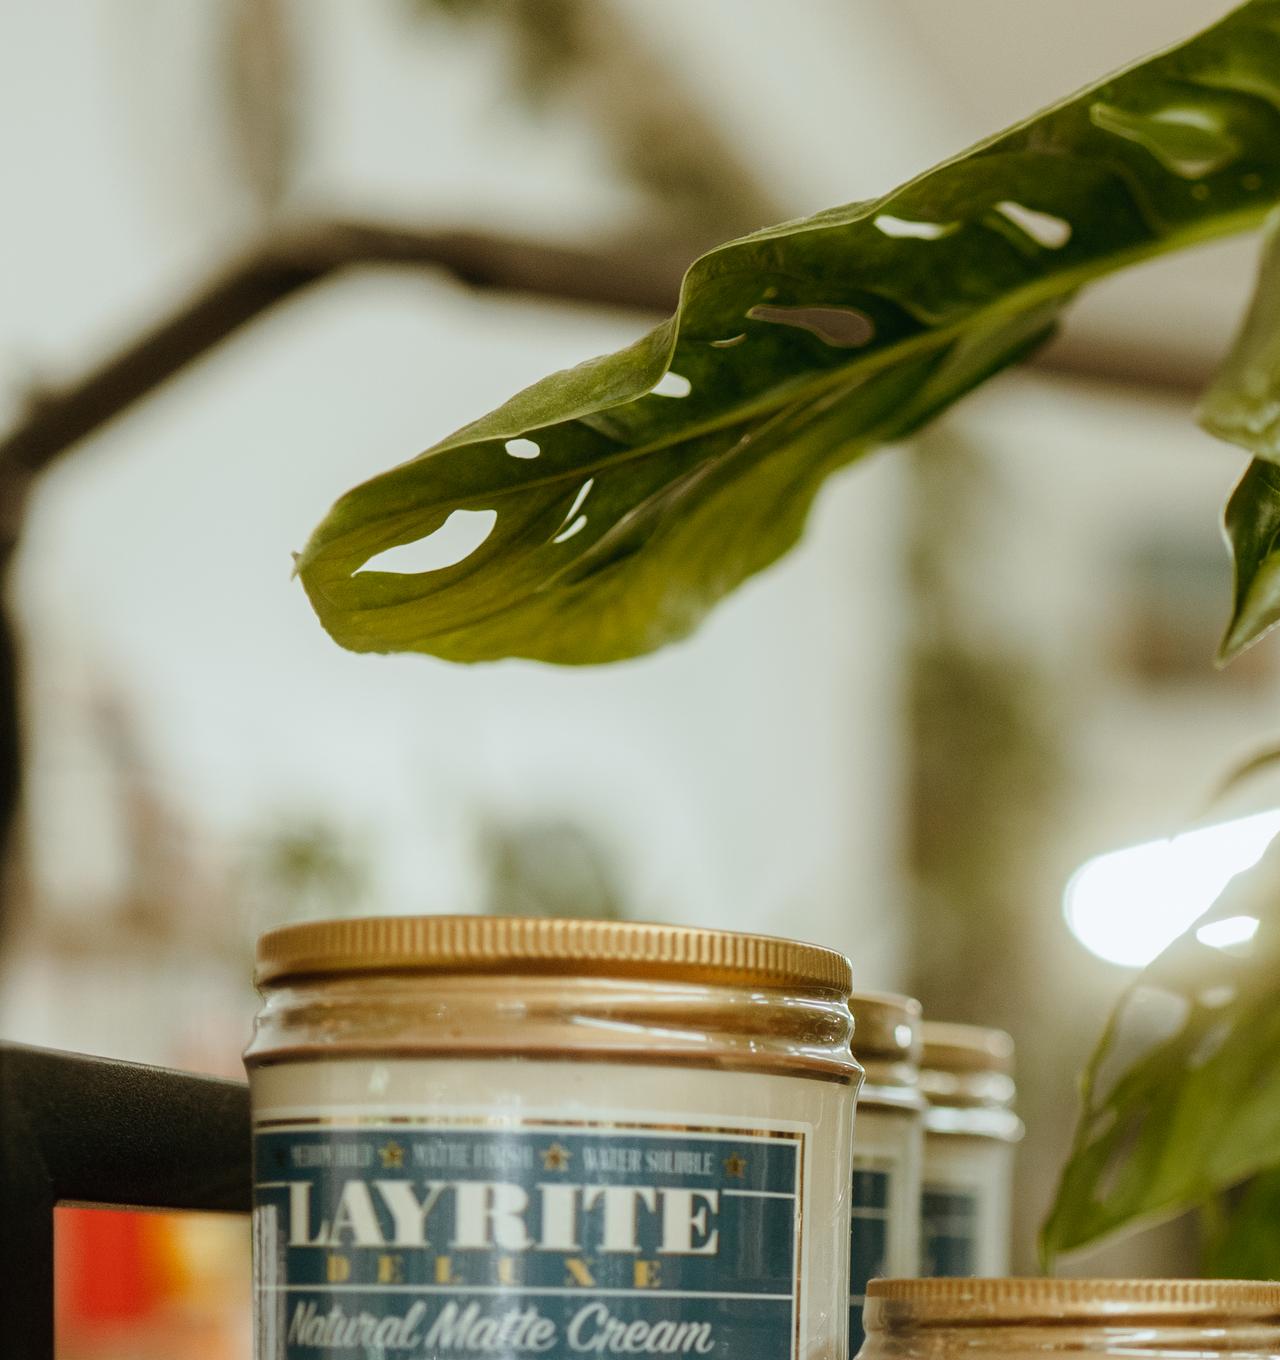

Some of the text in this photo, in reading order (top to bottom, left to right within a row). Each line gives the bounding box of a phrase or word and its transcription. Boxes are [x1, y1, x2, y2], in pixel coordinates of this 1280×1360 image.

[288, 1179, 720, 1256] LAYRITE
[287, 1301, 716, 1355] Natural Matte Cream
